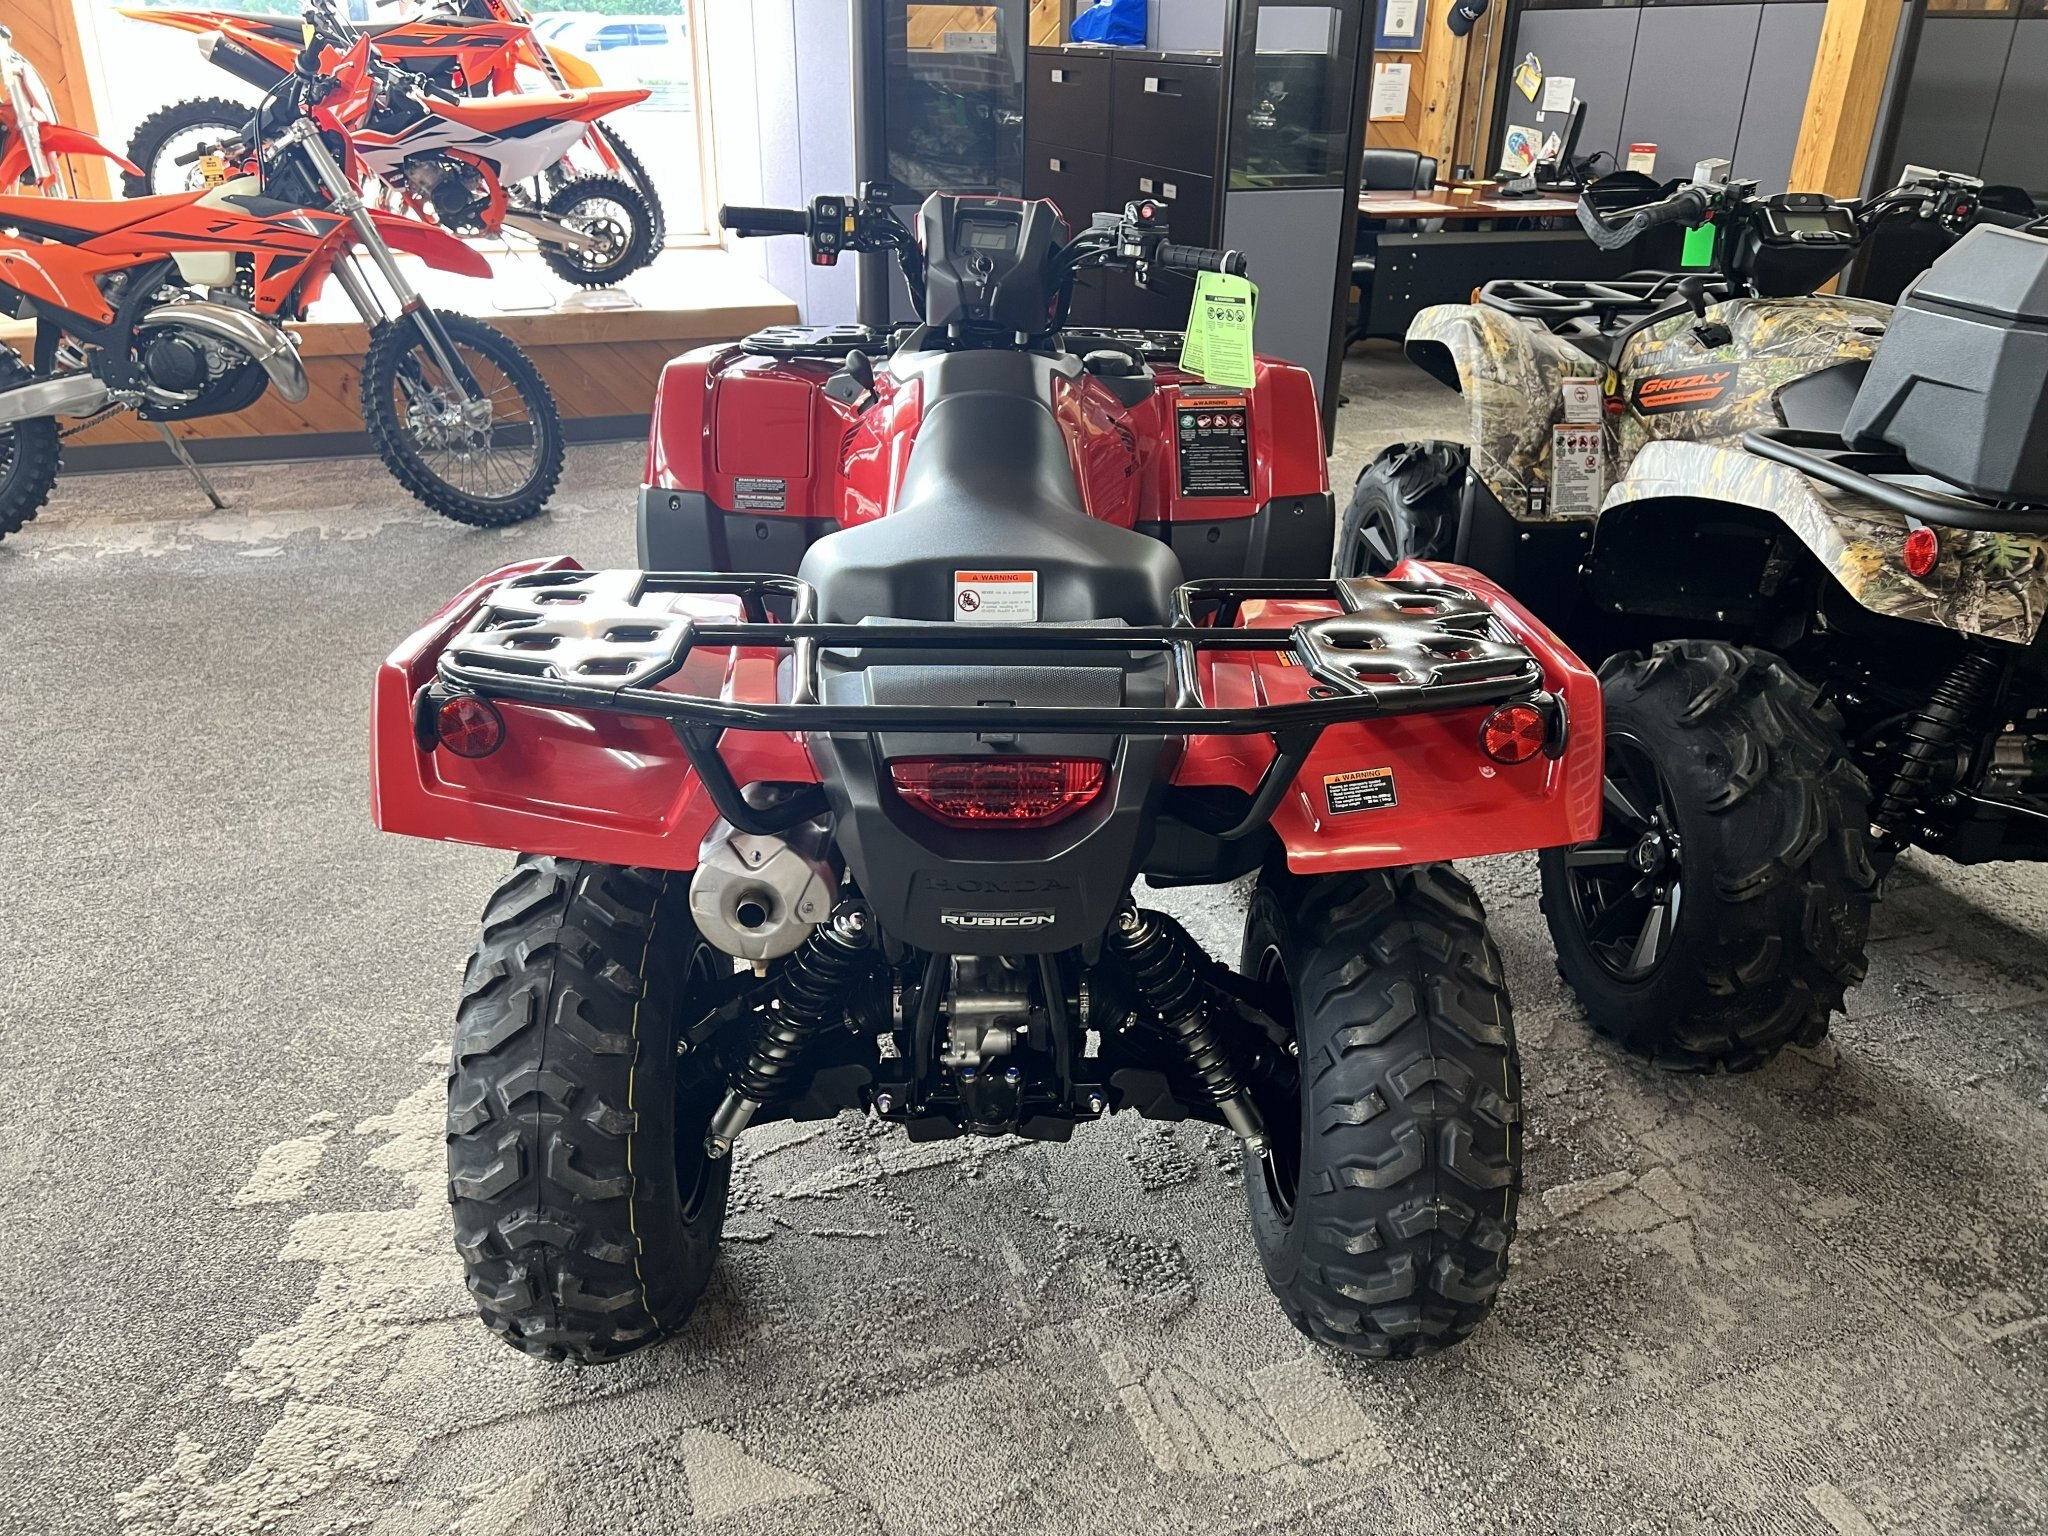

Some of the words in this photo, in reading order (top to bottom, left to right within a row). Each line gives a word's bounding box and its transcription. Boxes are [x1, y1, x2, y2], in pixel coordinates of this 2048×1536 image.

[1639, 371, 1731, 395] GRIZZLY
[1342, 770, 1381, 780] WARNING
[925, 878, 1072, 893] HONDA
[940, 914, 1055, 926] RUBICON
